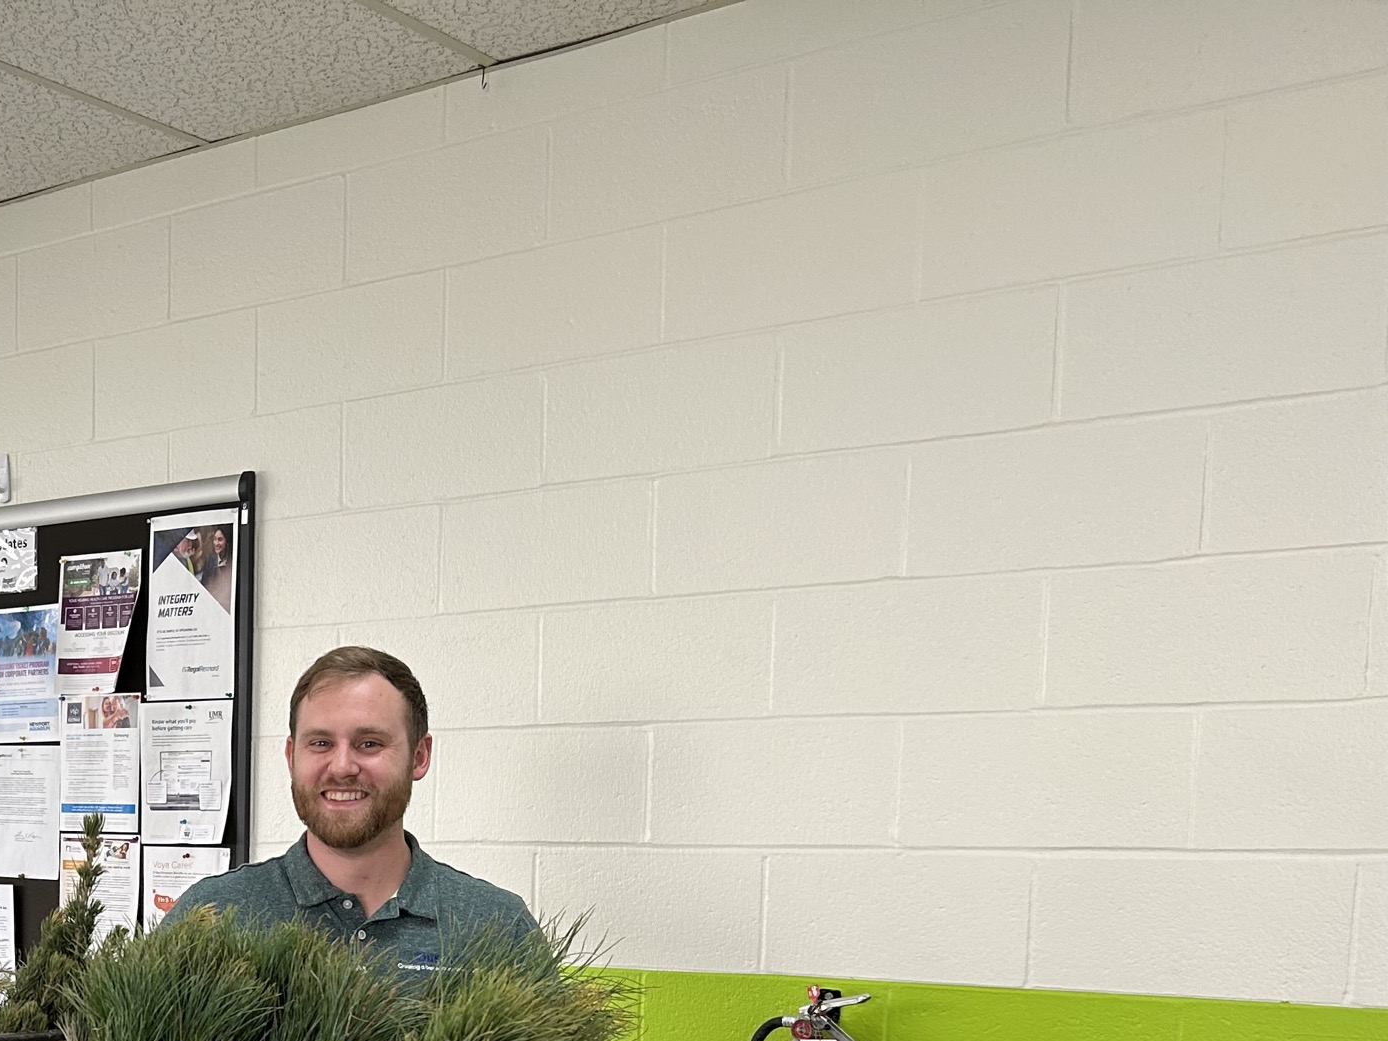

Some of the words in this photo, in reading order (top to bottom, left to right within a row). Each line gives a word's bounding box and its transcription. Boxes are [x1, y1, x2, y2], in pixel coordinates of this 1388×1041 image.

[157, 592, 200, 606] INTEGRITY
[157, 606, 194, 619] MATTERS
[5, 669, 27, 678] CORPORATE
[27, 668, 49, 676] PARTNERS
[208, 711, 223, 719] UMR
[153, 860, 170, 871] Voya
